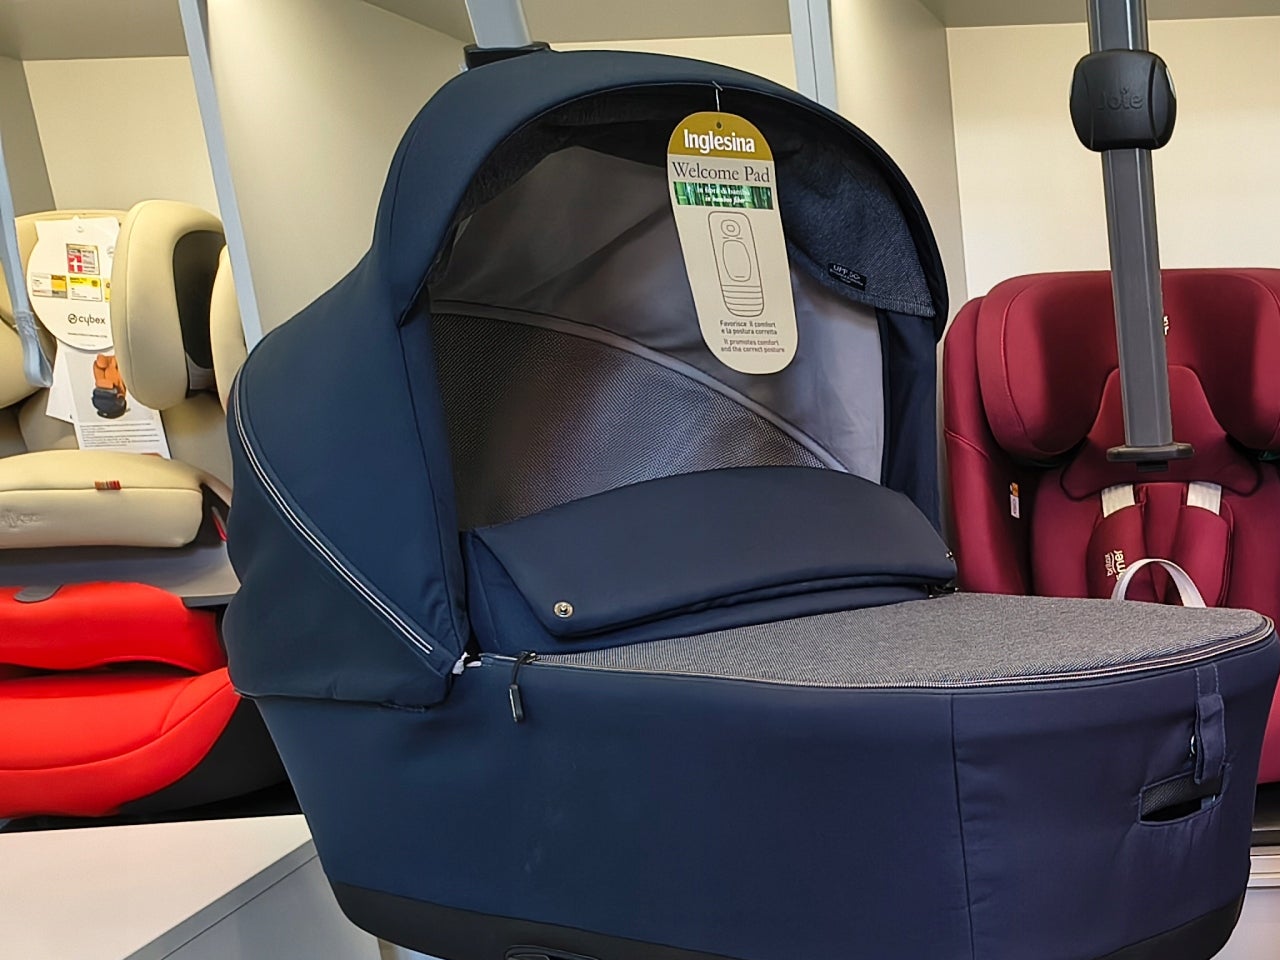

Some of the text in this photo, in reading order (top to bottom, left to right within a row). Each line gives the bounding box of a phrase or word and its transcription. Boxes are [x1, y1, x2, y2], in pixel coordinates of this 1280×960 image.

[683, 129, 756, 154] Inglesina
[671, 161, 771, 183] Welcome Pad
[78, 314, 106, 327] cybex
